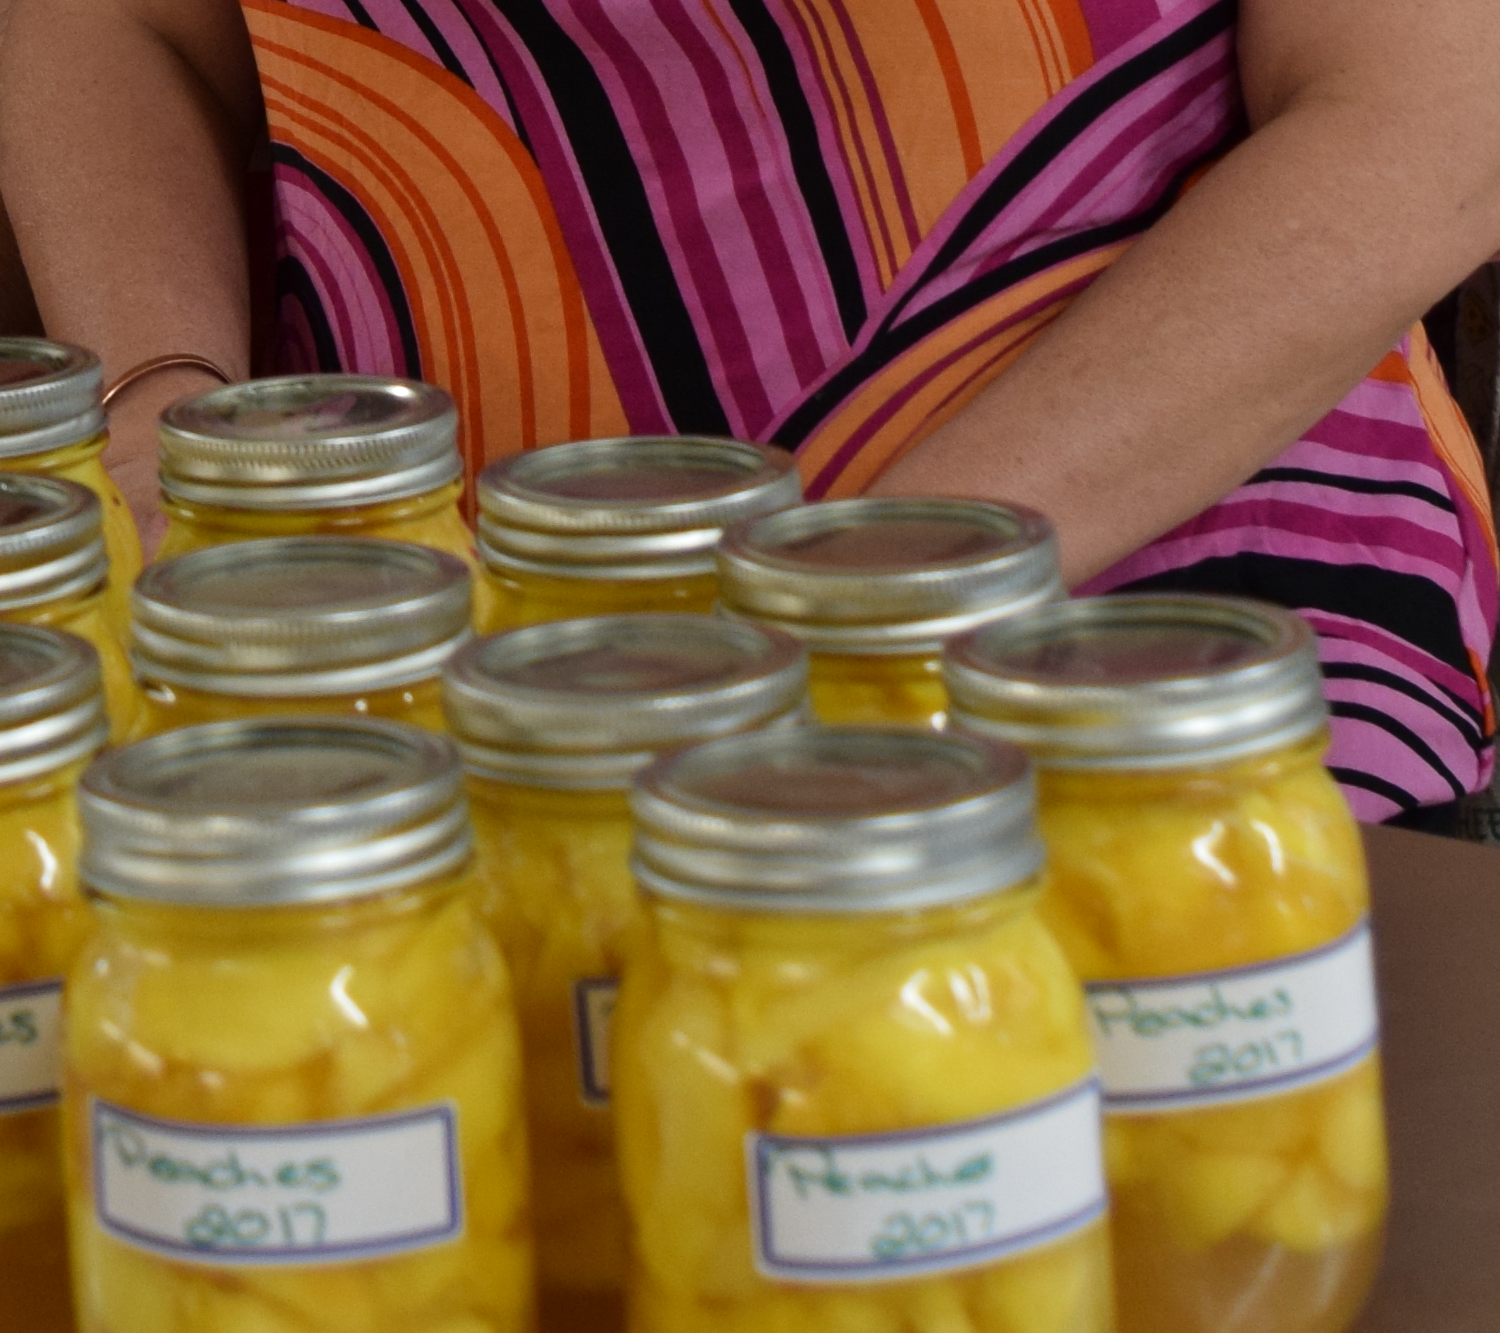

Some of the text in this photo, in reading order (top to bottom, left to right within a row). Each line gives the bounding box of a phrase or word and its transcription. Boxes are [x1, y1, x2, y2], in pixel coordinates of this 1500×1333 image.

[102, 1116, 341, 1193] Peaches
[184, 1201, 329, 1247] 2017
[872, 1201, 996, 1262] 2017
